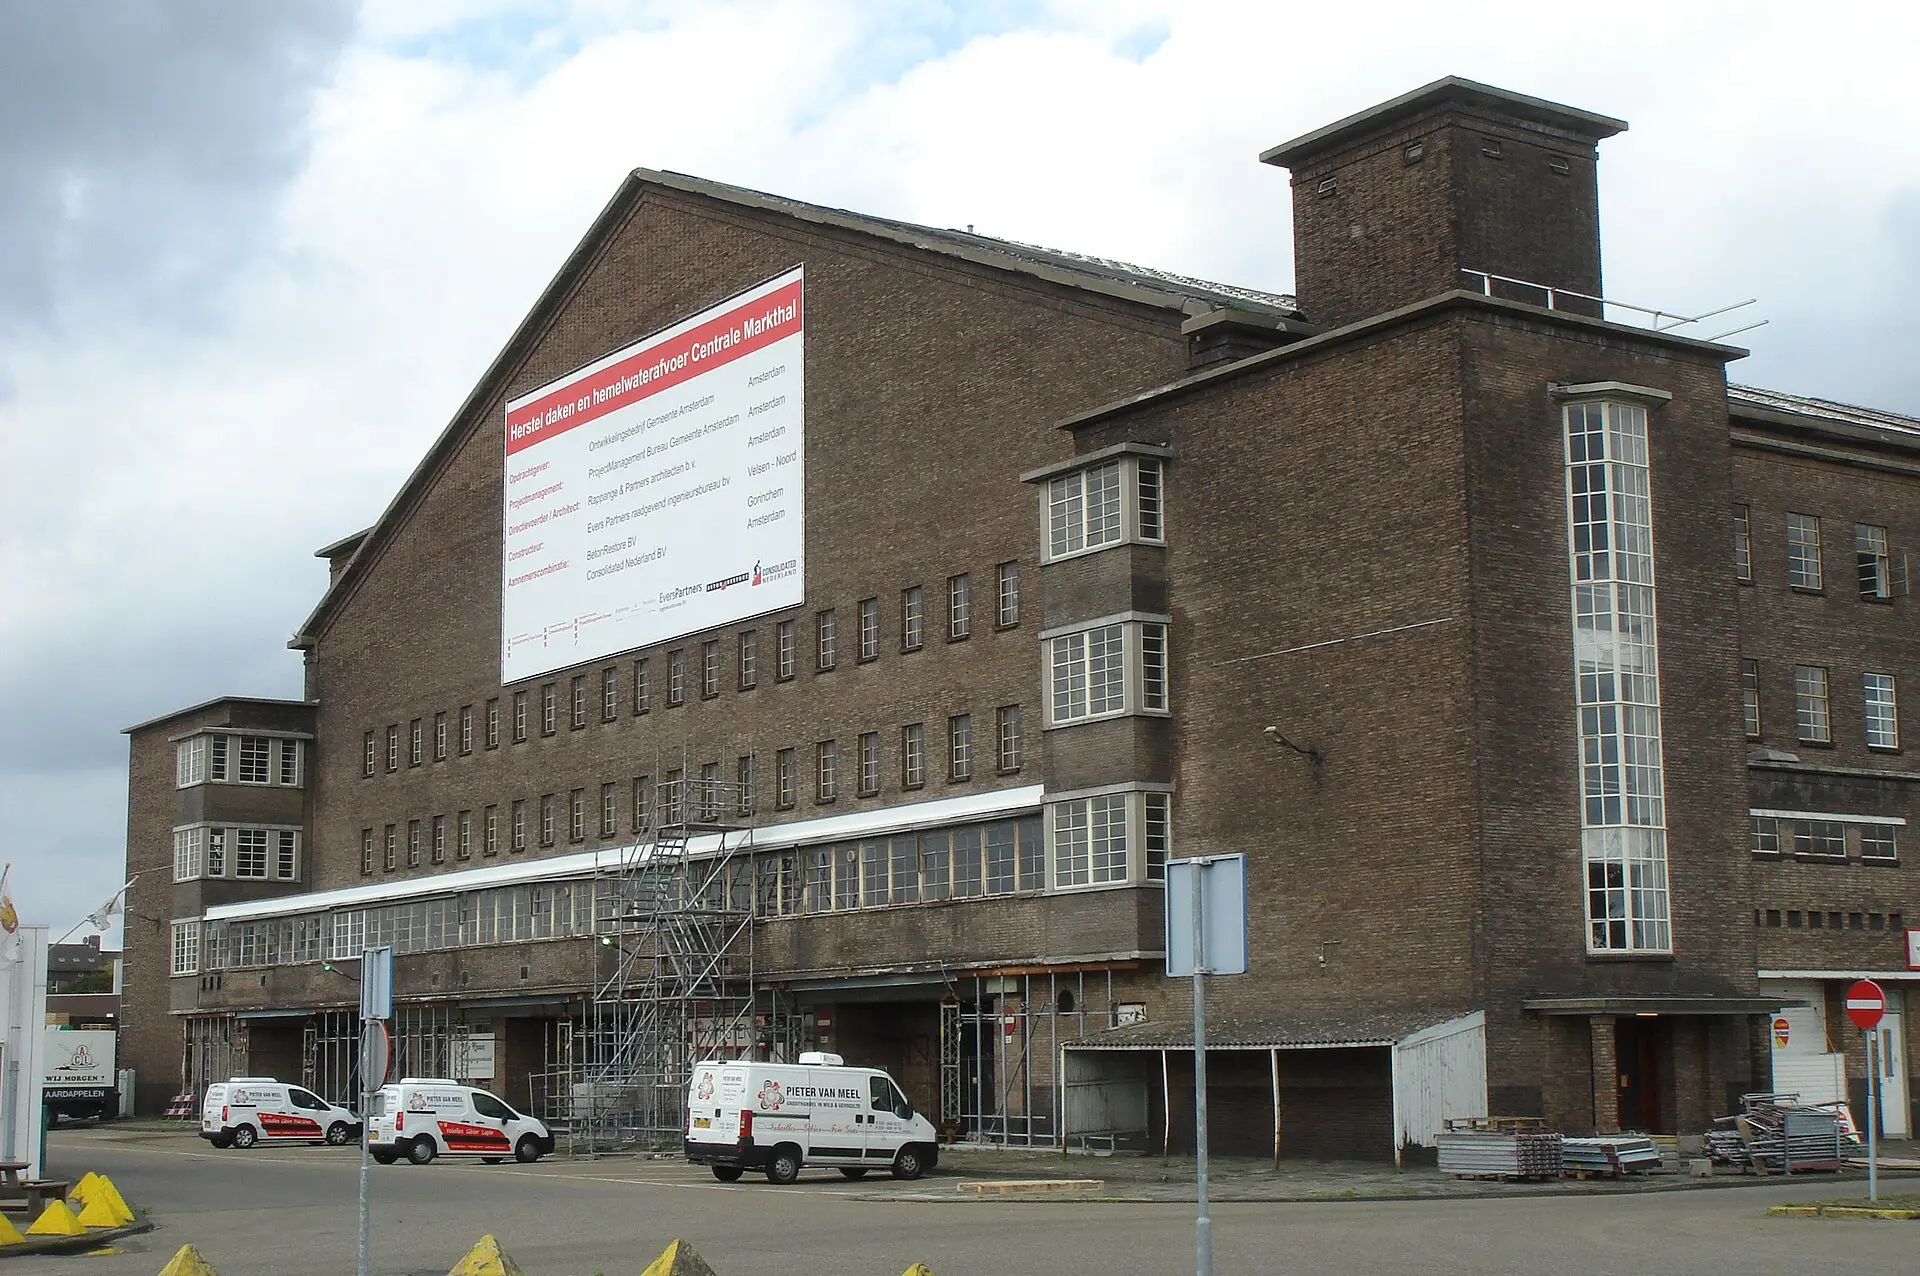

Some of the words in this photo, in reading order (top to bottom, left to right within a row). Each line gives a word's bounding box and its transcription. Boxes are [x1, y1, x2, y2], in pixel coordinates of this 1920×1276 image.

[510, 411, 543, 442] Herstel
[545, 402, 575, 425] daken
[577, 395, 590, 412] en
[593, 351, 689, 406] hemelwaterafvoer
[691, 326, 741, 362] Centrale
[743, 298, 797, 340] Markthal
[748, 364, 786, 388] Amsterdam
[748, 394, 786, 418] Amsterdam
[588, 419, 646, 452] Ontwikkelingsbedrijf
[646, 408, 678, 429] Gemeente
[679, 394, 715, 414] Amsterdam
[588, 449, 646, 479] ProjectManagement
[646, 441, 669, 458] Bureau
[669, 427, 703, 448] Gemeente
[702, 413, 740, 436] Amsterdam
[748, 425, 786, 448] Amsterdam
[509, 461, 550, 485] Opdrachtgever:
[747, 461, 770, 477] Velsen
[776, 450, 797, 468] Noord
[619, 485, 624, 496] &
[625, 476, 649, 493] Partners
[651, 463, 684, 483] architecten
[685, 460, 696, 471] b.v.
[509, 481, 564, 511] Projectmanagement:
[587, 520, 604, 534] Evers
[605, 511, 630, 528] Partners
[631, 497, 667, 517] raadgevend
[667, 481, 720, 507] ingenieursbureau
[722, 475, 730, 487] bv
[747, 486, 784, 508] Gorinchem
[508, 513, 548, 536] Directievoerder
[552, 501, 581, 520] Architect:
[747, 508, 785, 530] Amsterdam
[508, 542, 544, 561] Constructeur:
[586, 541, 627, 561] BetonRestore
[627, 536, 637, 548] BV
[508, 560, 569, 588] Aannemerscombinatie:
[586, 559, 624, 581] Consolidated
[625, 549, 656, 569] Nederland
[657, 546, 667, 559] BV
[762, 559, 797, 576] CONSOLIDATED
[762, 568, 797, 583] NEDERLAND
[659, 583, 703, 603] EversPartners
[80, 1047, 85, 1056] A
[45, 1090, 105, 1098] AARDAPPELEN
[786, 1086, 816, 1098] PIETER
[818, 1087, 836, 1098] VAN
[838, 1088, 861, 1099] MEEL
